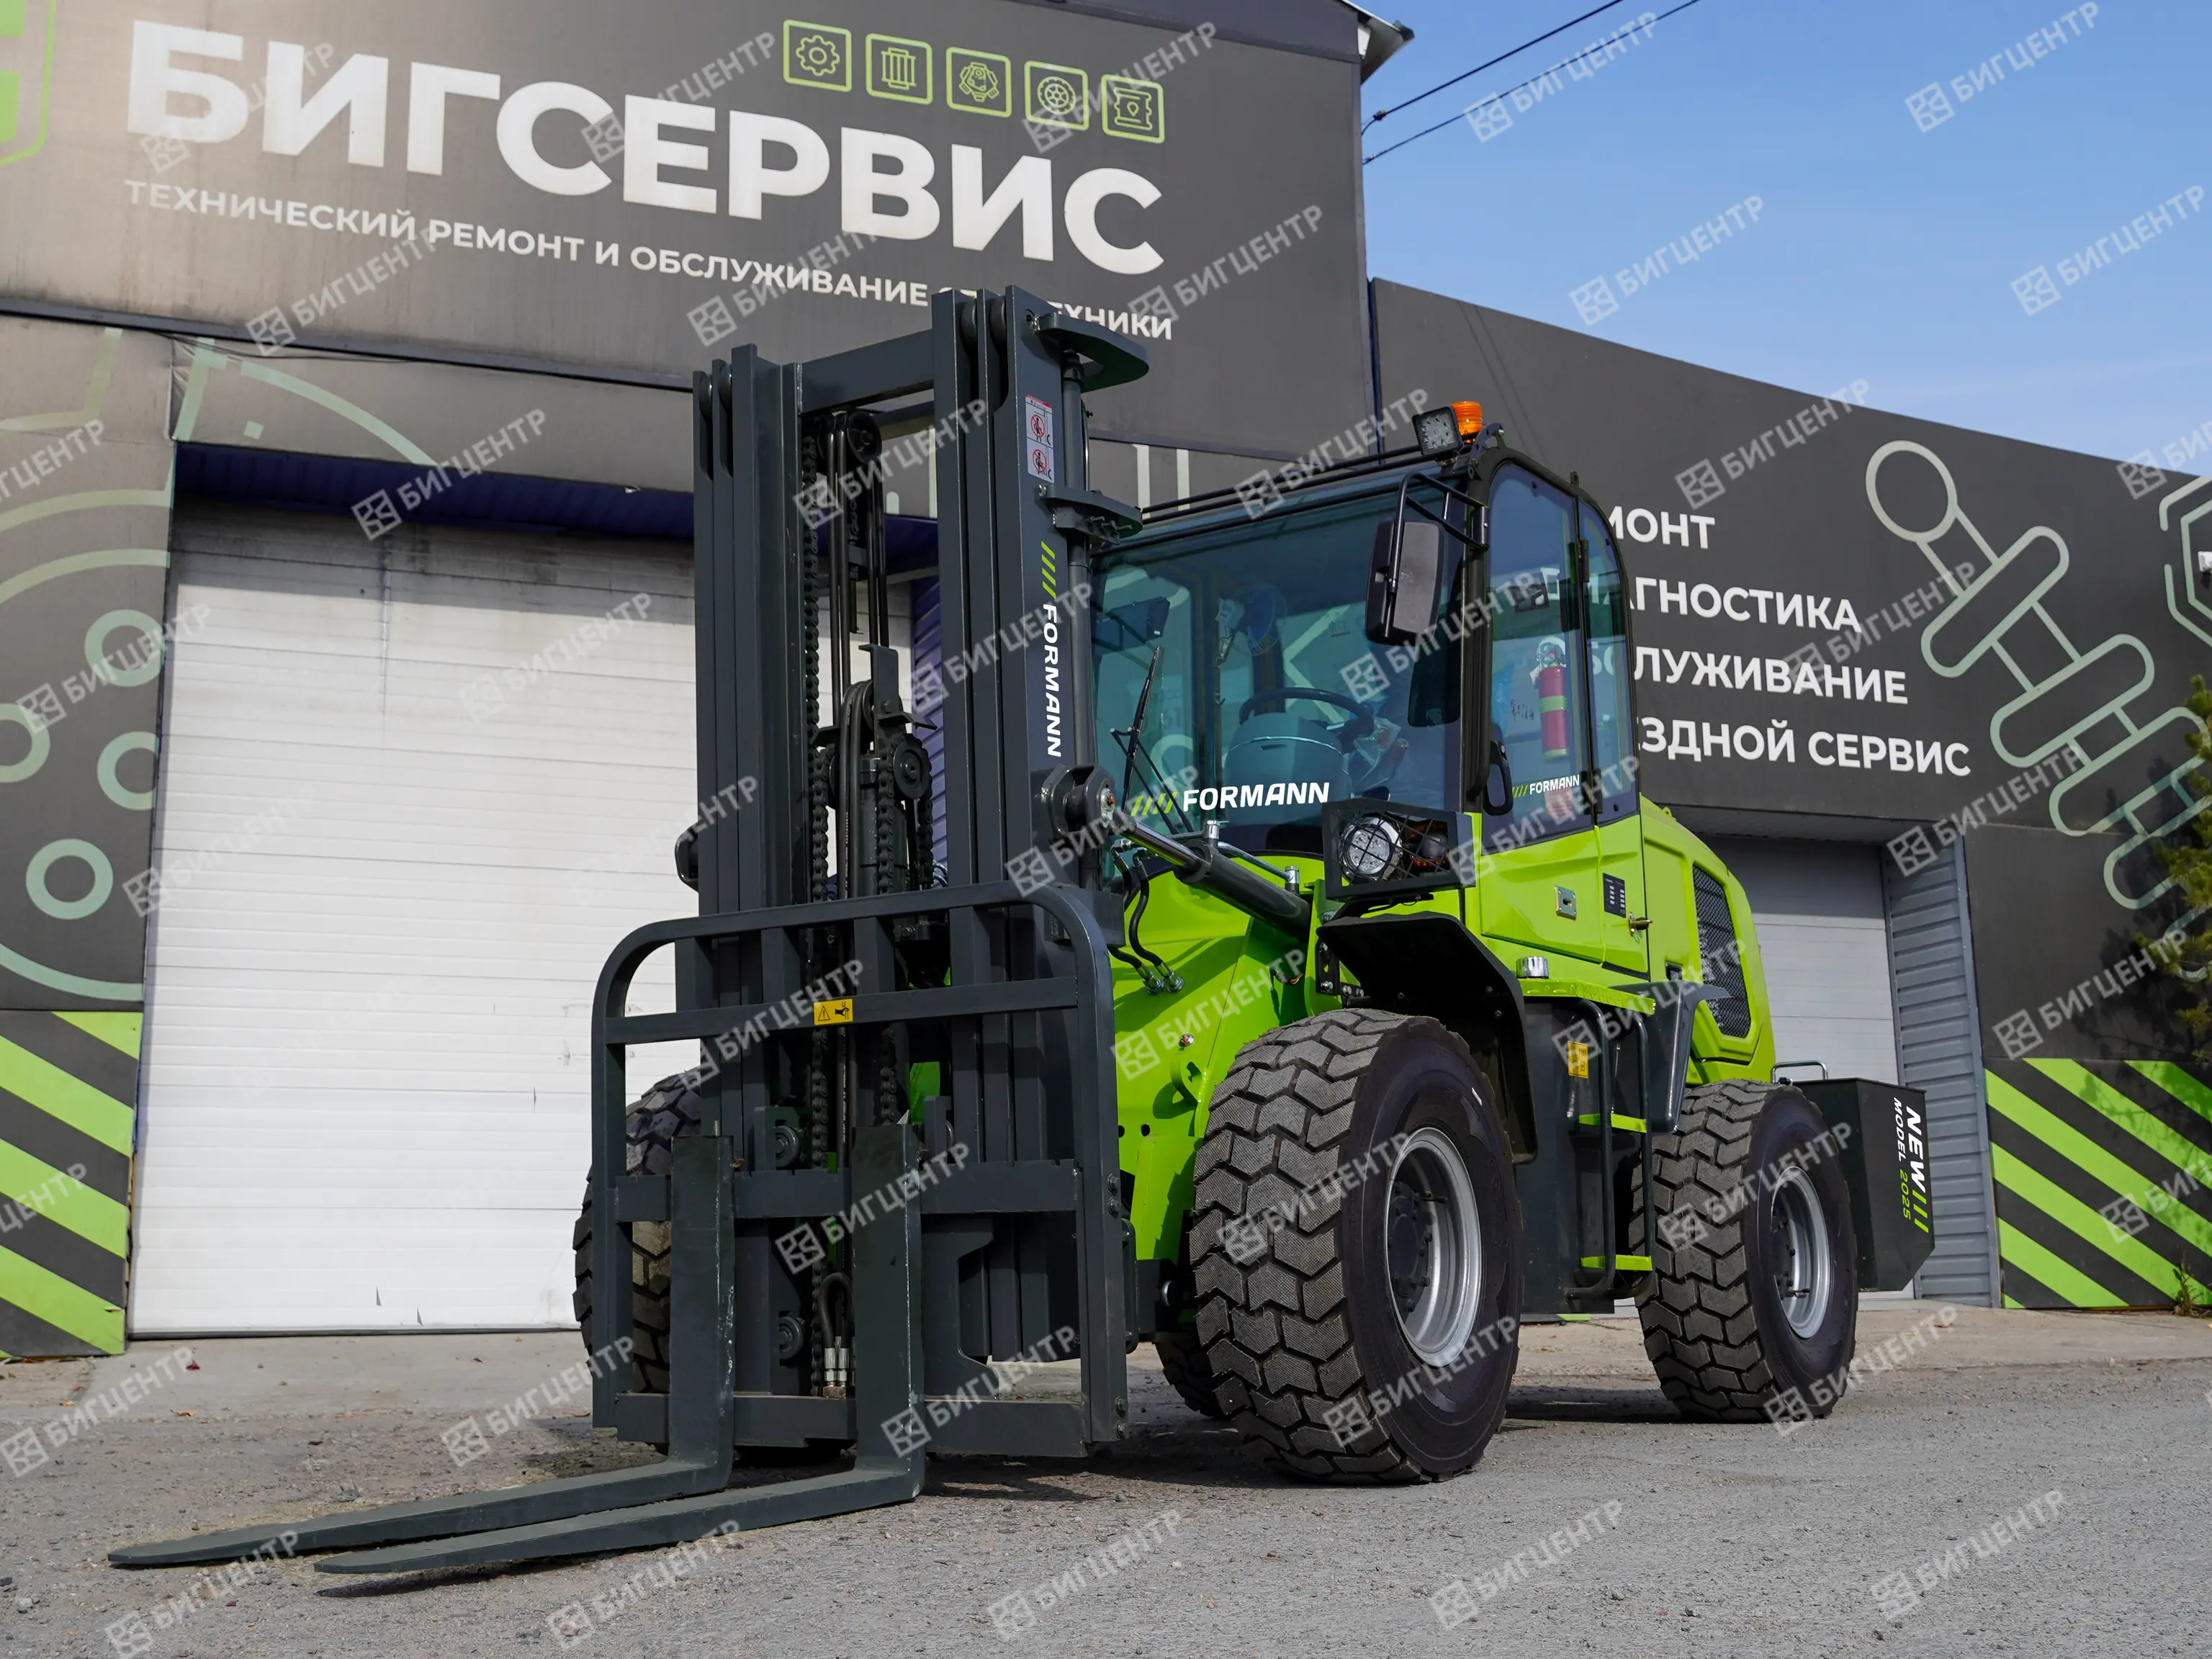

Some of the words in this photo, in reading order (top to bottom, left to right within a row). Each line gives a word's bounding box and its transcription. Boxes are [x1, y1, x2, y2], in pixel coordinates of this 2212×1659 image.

[127, 19, 1164, 274] БИГСЕРВИС
[124, 179, 415, 240] ТЕХНИЧЕСКИЙ
[428, 220, 585, 261] РЕМОНТ
[595, 240, 619, 266] И
[631, 246, 928, 306] ОБСЛУЖИВАНИЕ
[1043, 603, 1061, 757] FORMANN
[1637, 716, 1796, 763] ЗДНОЙ
[1807, 731, 1972, 777] СЕРВИС
[1183, 781, 1330, 812] FORMANN
[1529, 774, 1580, 795] FORMANN
[1893, 1097, 1907, 1162] MODEL
[1906, 1105, 1926, 1193] NEW
[1899, 1169, 1912, 1220] 2025
